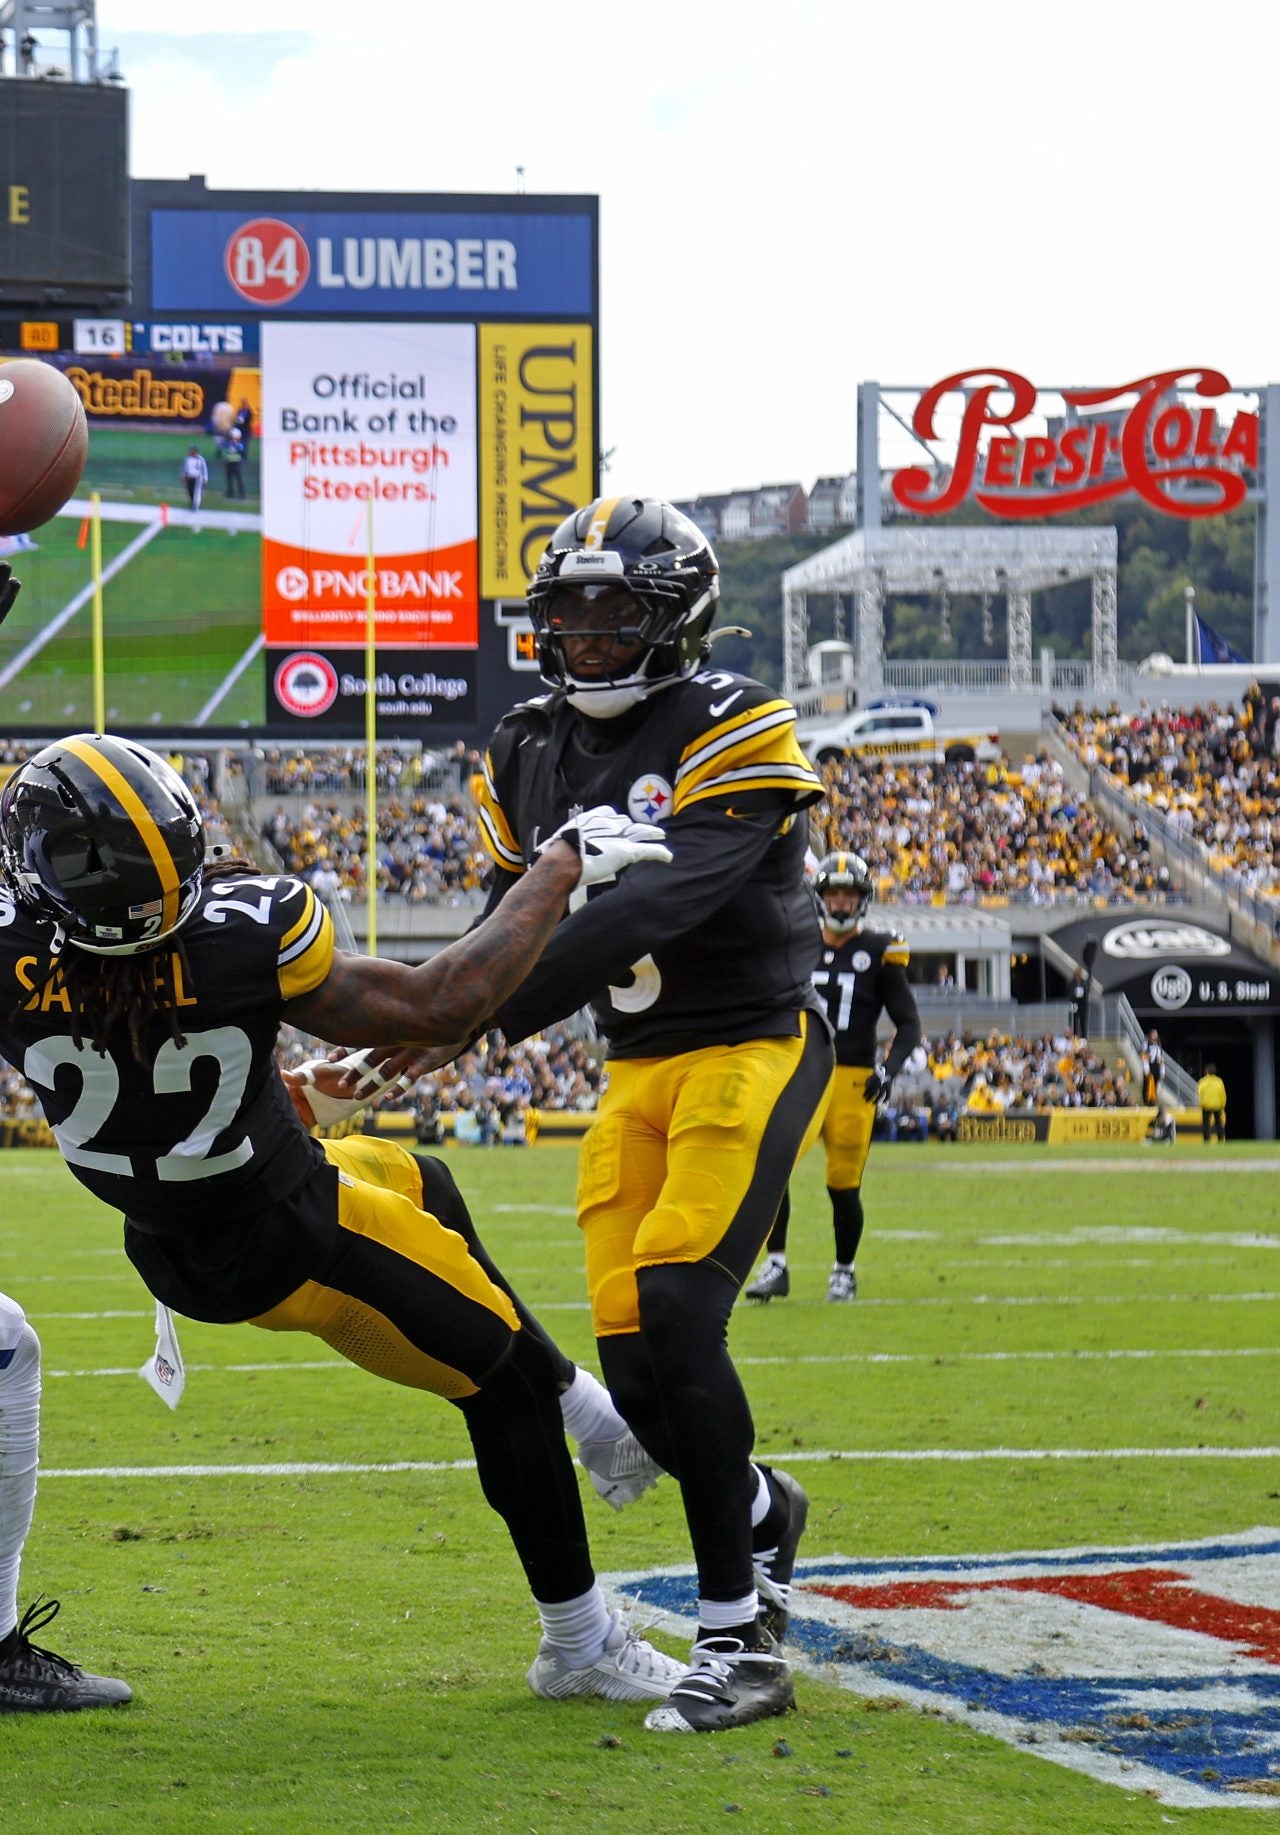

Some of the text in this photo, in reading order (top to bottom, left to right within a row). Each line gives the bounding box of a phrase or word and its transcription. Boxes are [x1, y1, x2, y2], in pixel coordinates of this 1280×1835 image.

[237, 236, 518, 290] 84 LUMBER
[88, 326, 114, 346] 16
[151, 325, 244, 352] COLTS
[66, 366, 204, 419] Steelers
[313, 374, 426, 400] Official
[281, 408, 459, 435] Bank of the
[289, 442, 450, 474] Pittsburgh
[494, 344, 509, 582] LIFE CHANGING MEDICINE
[304, 474, 437, 501] Steelers.
[587, 520, 607, 552] 5
[576, 554, 605, 566] Steelers
[312, 569, 464, 599] PNC BANK
[398, 673, 468, 700] College
[691, 669, 734, 691] 5
[202, 877, 281, 925] 22
[1235, 980, 1270, 1001] Steel
[24, 1025, 255, 1182] 22
